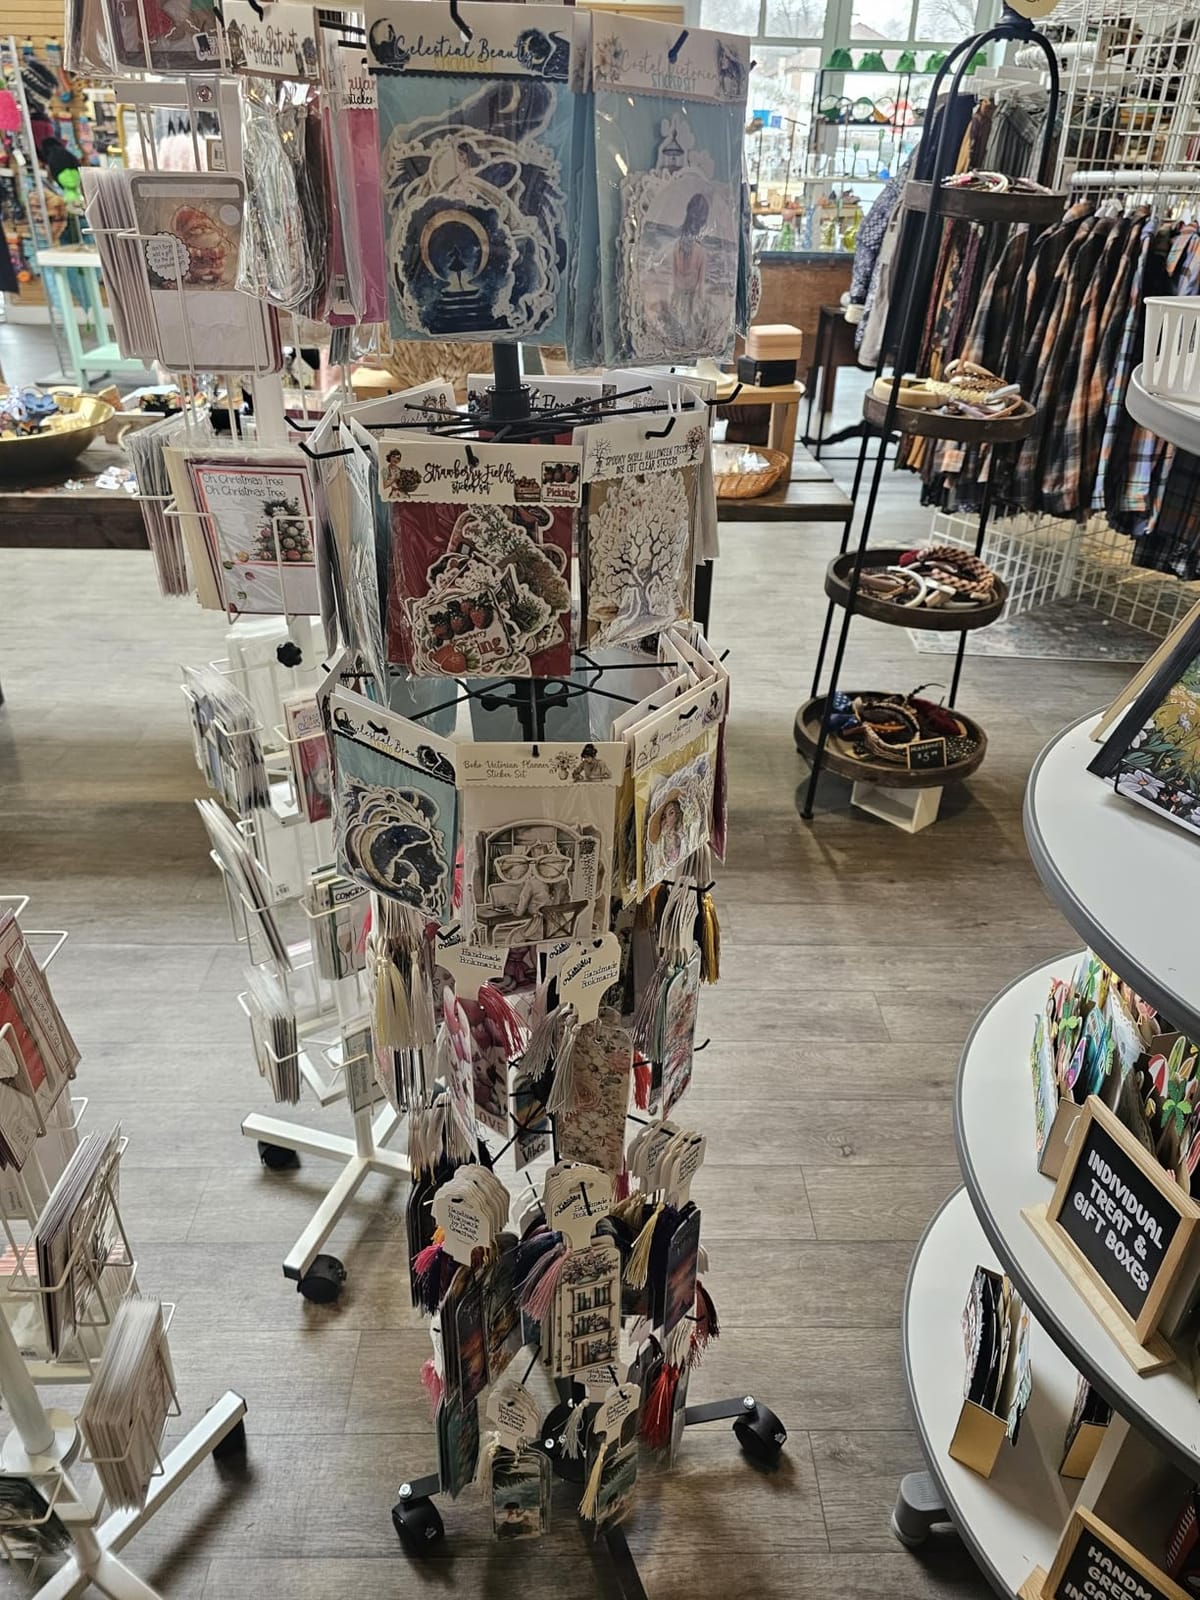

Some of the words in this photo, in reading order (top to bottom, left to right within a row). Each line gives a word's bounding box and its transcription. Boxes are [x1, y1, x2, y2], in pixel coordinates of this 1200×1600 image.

[394, 35, 475, 59] Celestial
[639, 460, 656, 471] CLEAR
[218, 474, 262, 486] Christmas
[263, 474, 284, 486] Tree
[423, 459, 481, 488] Strawberry
[481, 463, 516, 484] Fields
[221, 485, 265, 497] Christmas
[266, 486, 286, 498] Tree
[546, 487, 576, 501] Picking
[486, 760, 518, 769] Victorian
[522, 760, 549, 769] Planner
[486, 769, 511, 779] Sticker
[514, 770, 527, 779] Set
[335, 886, 365, 901] CONGRA
[461, 948, 501, 962] Handmade
[1088, 1150, 1163, 1249] INDIVIDUAL
[1090, 1178, 1133, 1236] TREAT
[1134, 1235, 1147, 1260] &
[1073, 1192, 1107, 1234] GIFT
[1105, 1229, 1150, 1291] BOXES
